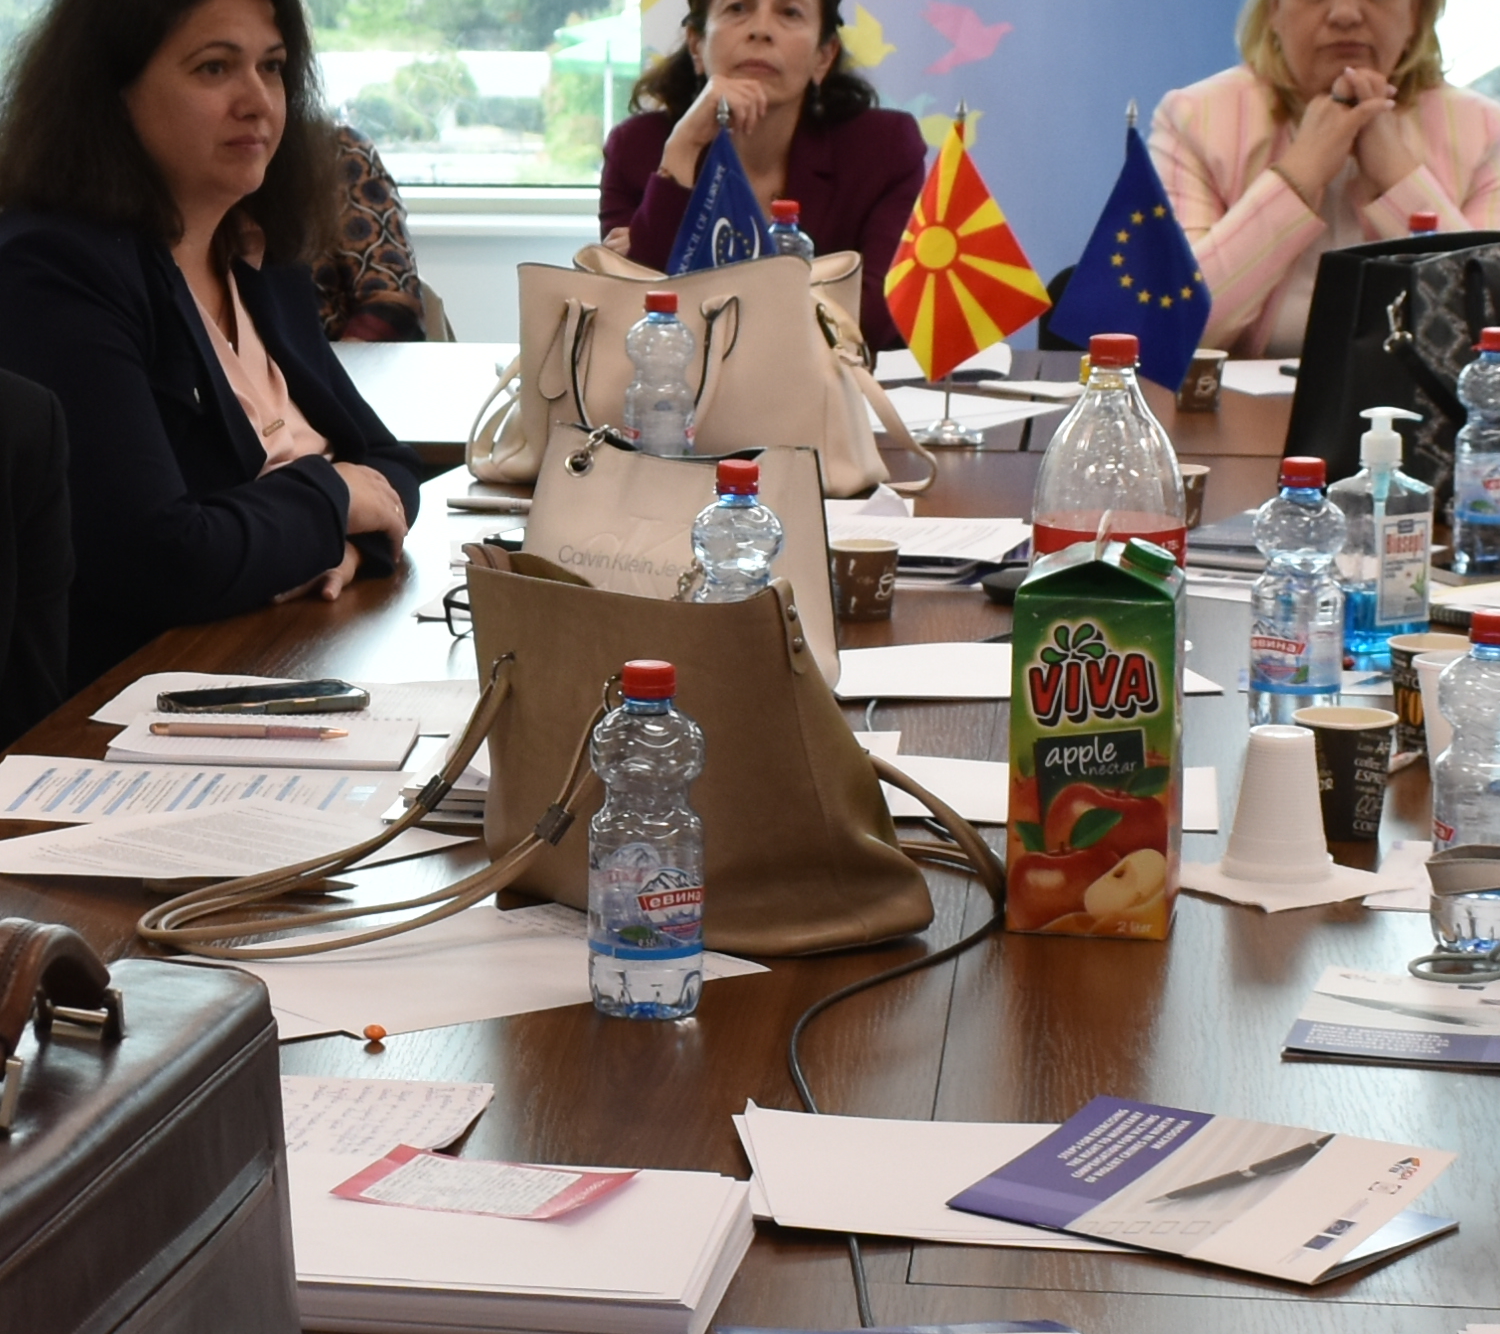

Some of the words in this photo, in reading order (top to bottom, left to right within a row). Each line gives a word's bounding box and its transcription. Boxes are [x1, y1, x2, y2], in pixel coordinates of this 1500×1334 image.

[558, 544, 610, 568] Calvin
[612, 553, 654, 575] Klein
[1028, 652, 1157, 727] VIVA
[1045, 736, 1117, 775] apple
[1088, 761, 1137, 776] nectar
